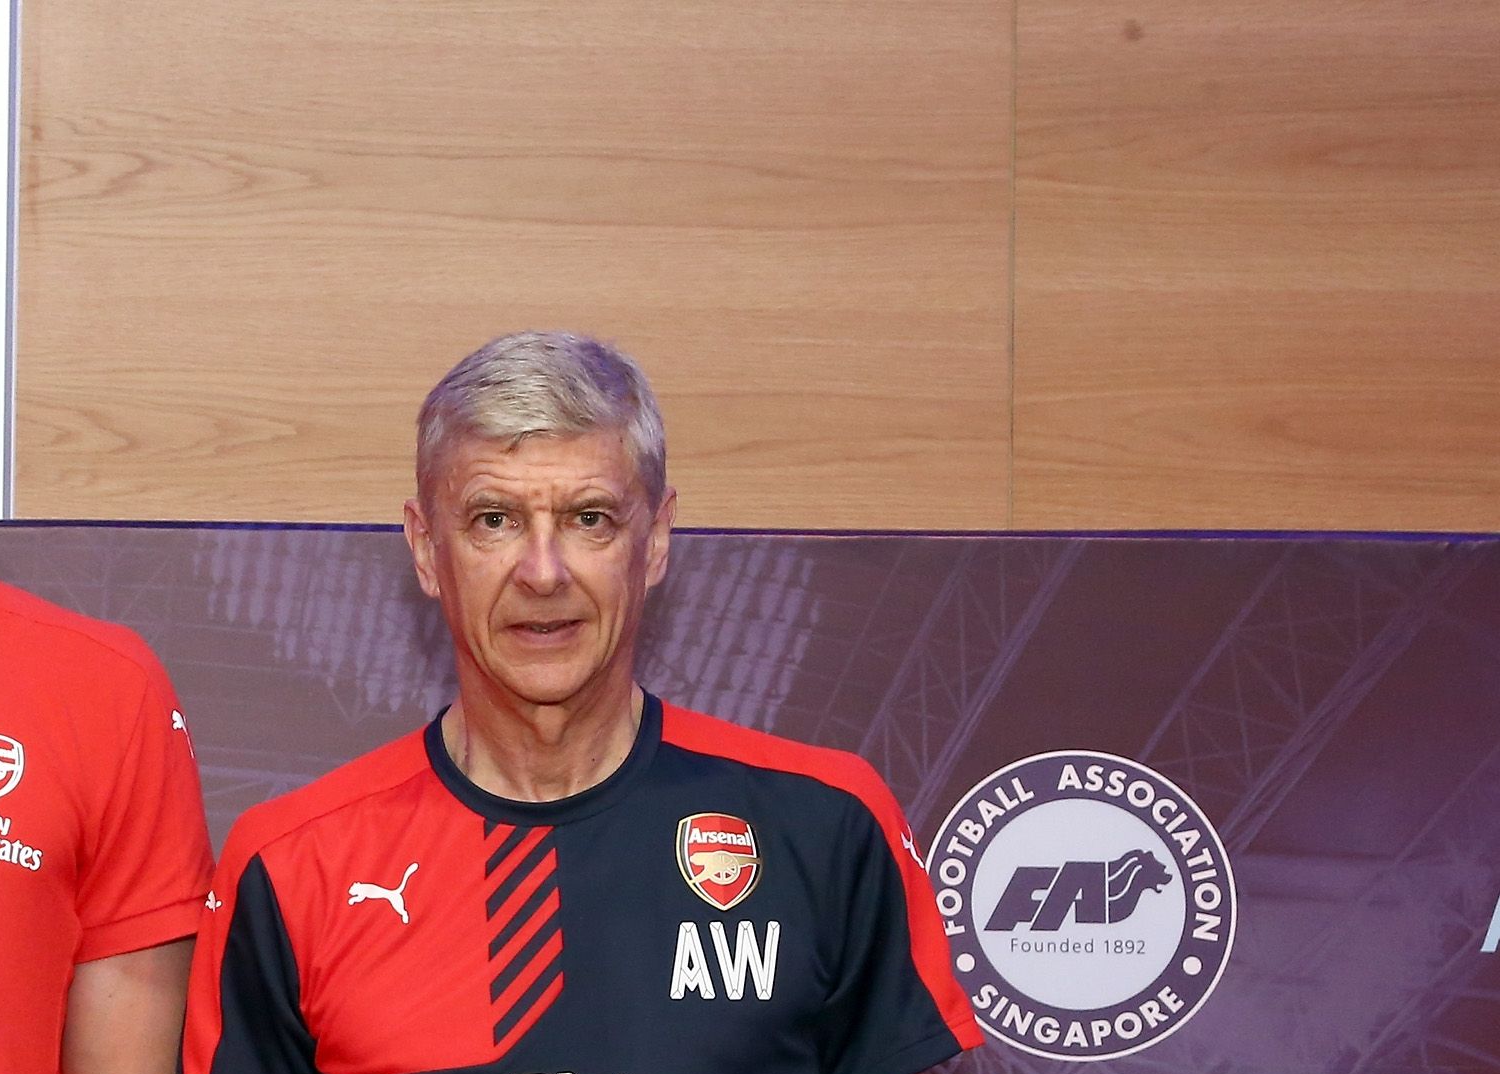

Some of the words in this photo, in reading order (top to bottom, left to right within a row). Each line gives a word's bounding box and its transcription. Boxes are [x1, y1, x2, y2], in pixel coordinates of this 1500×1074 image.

[688, 828, 750, 846] Arsenal
[936, 776, 1035, 936] FOOTBALL
[1057, 764, 1223, 942] ASSOCIATION
[670, 921, 780, 1000] AW
[1011, 938, 1093, 953] Founded
[1105, 940, 1145, 954] 1892
[972, 984, 1184, 1047] SINGAPORE
